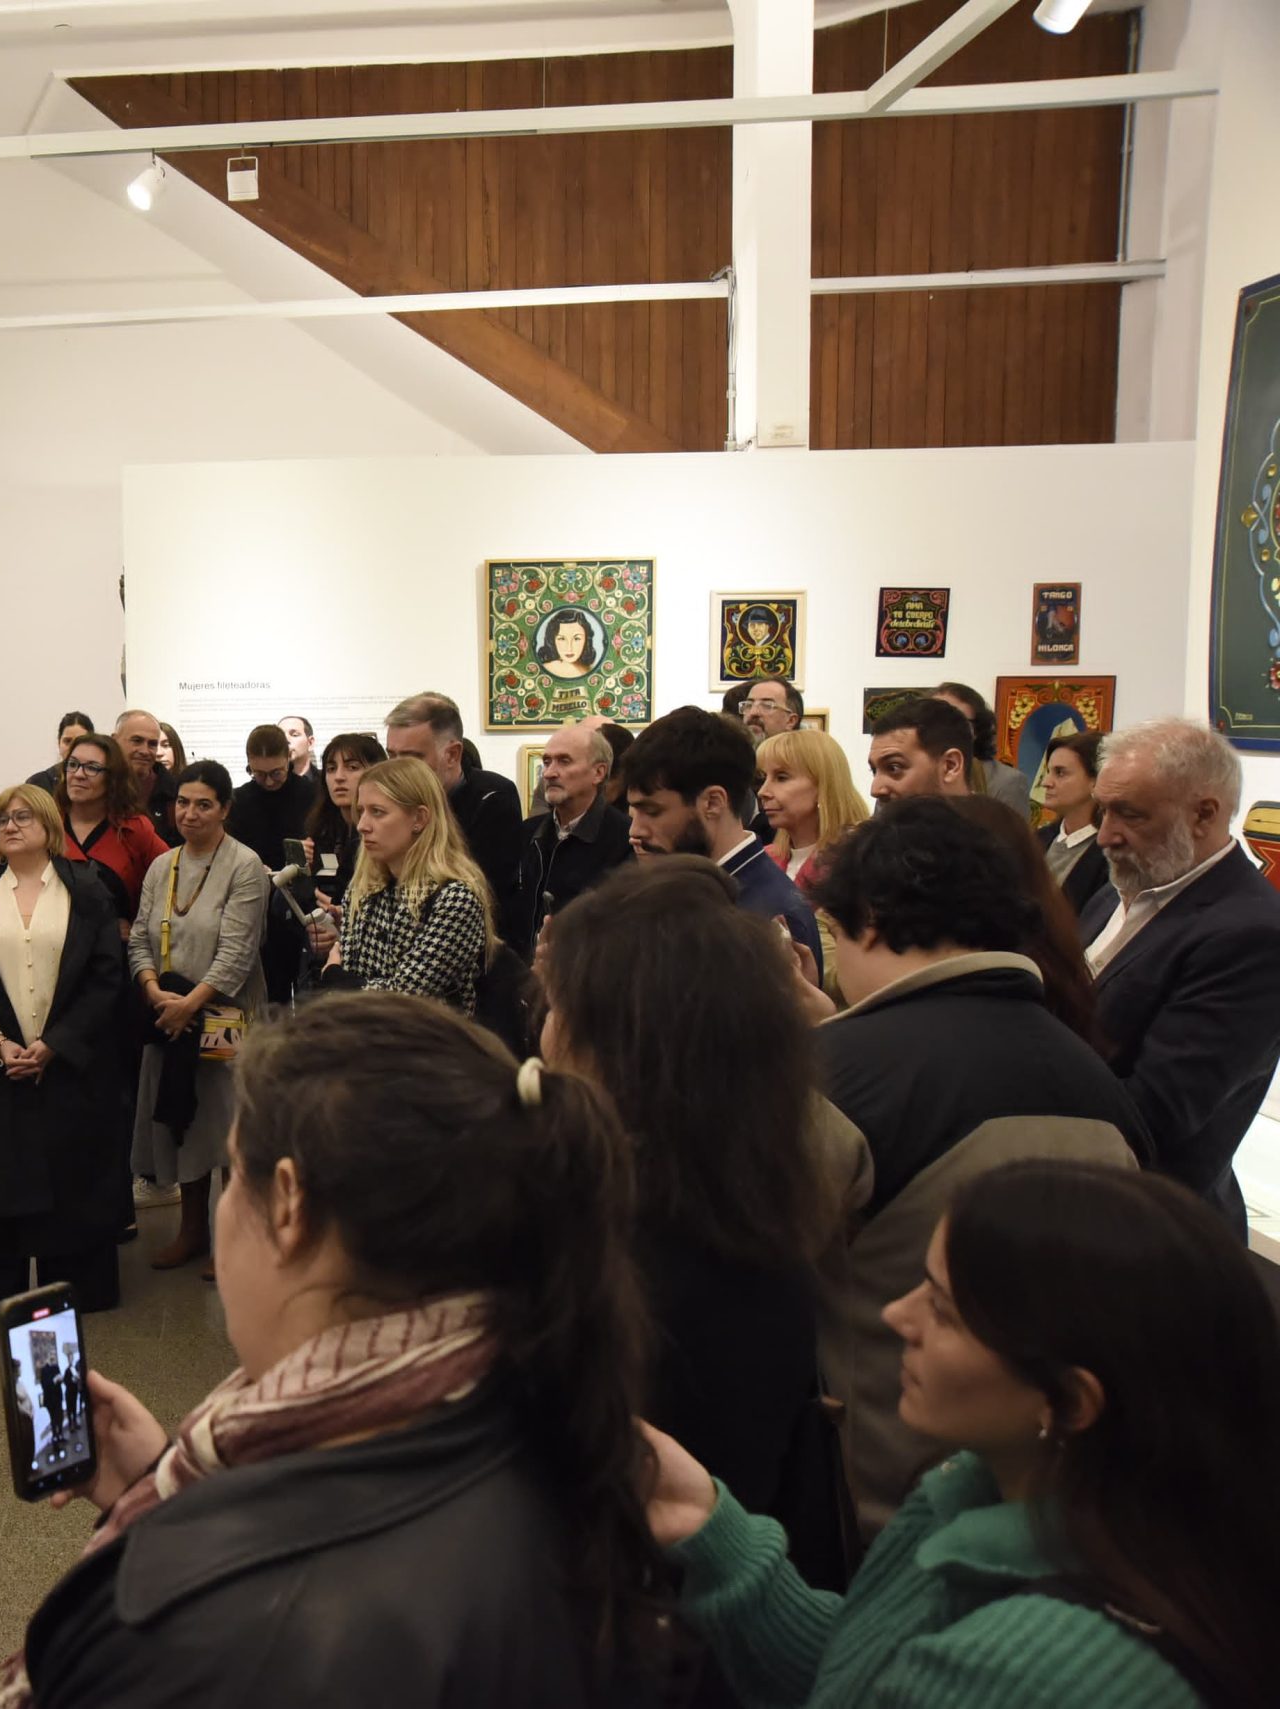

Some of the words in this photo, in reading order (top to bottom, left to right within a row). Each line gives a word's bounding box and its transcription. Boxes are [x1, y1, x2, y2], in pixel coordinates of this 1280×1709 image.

[1042, 591, 1072, 599] TANGO
[905, 602, 923, 610] AMA
[905, 611, 934, 619] CUERPO
[1037, 644, 1074, 652] MILONGA
[179, 682, 215, 691] Mujeres
[217, 681, 271, 690] fileteadoras
[558, 688, 580, 699] TITA
[551, 701, 587, 711] MERELLO
